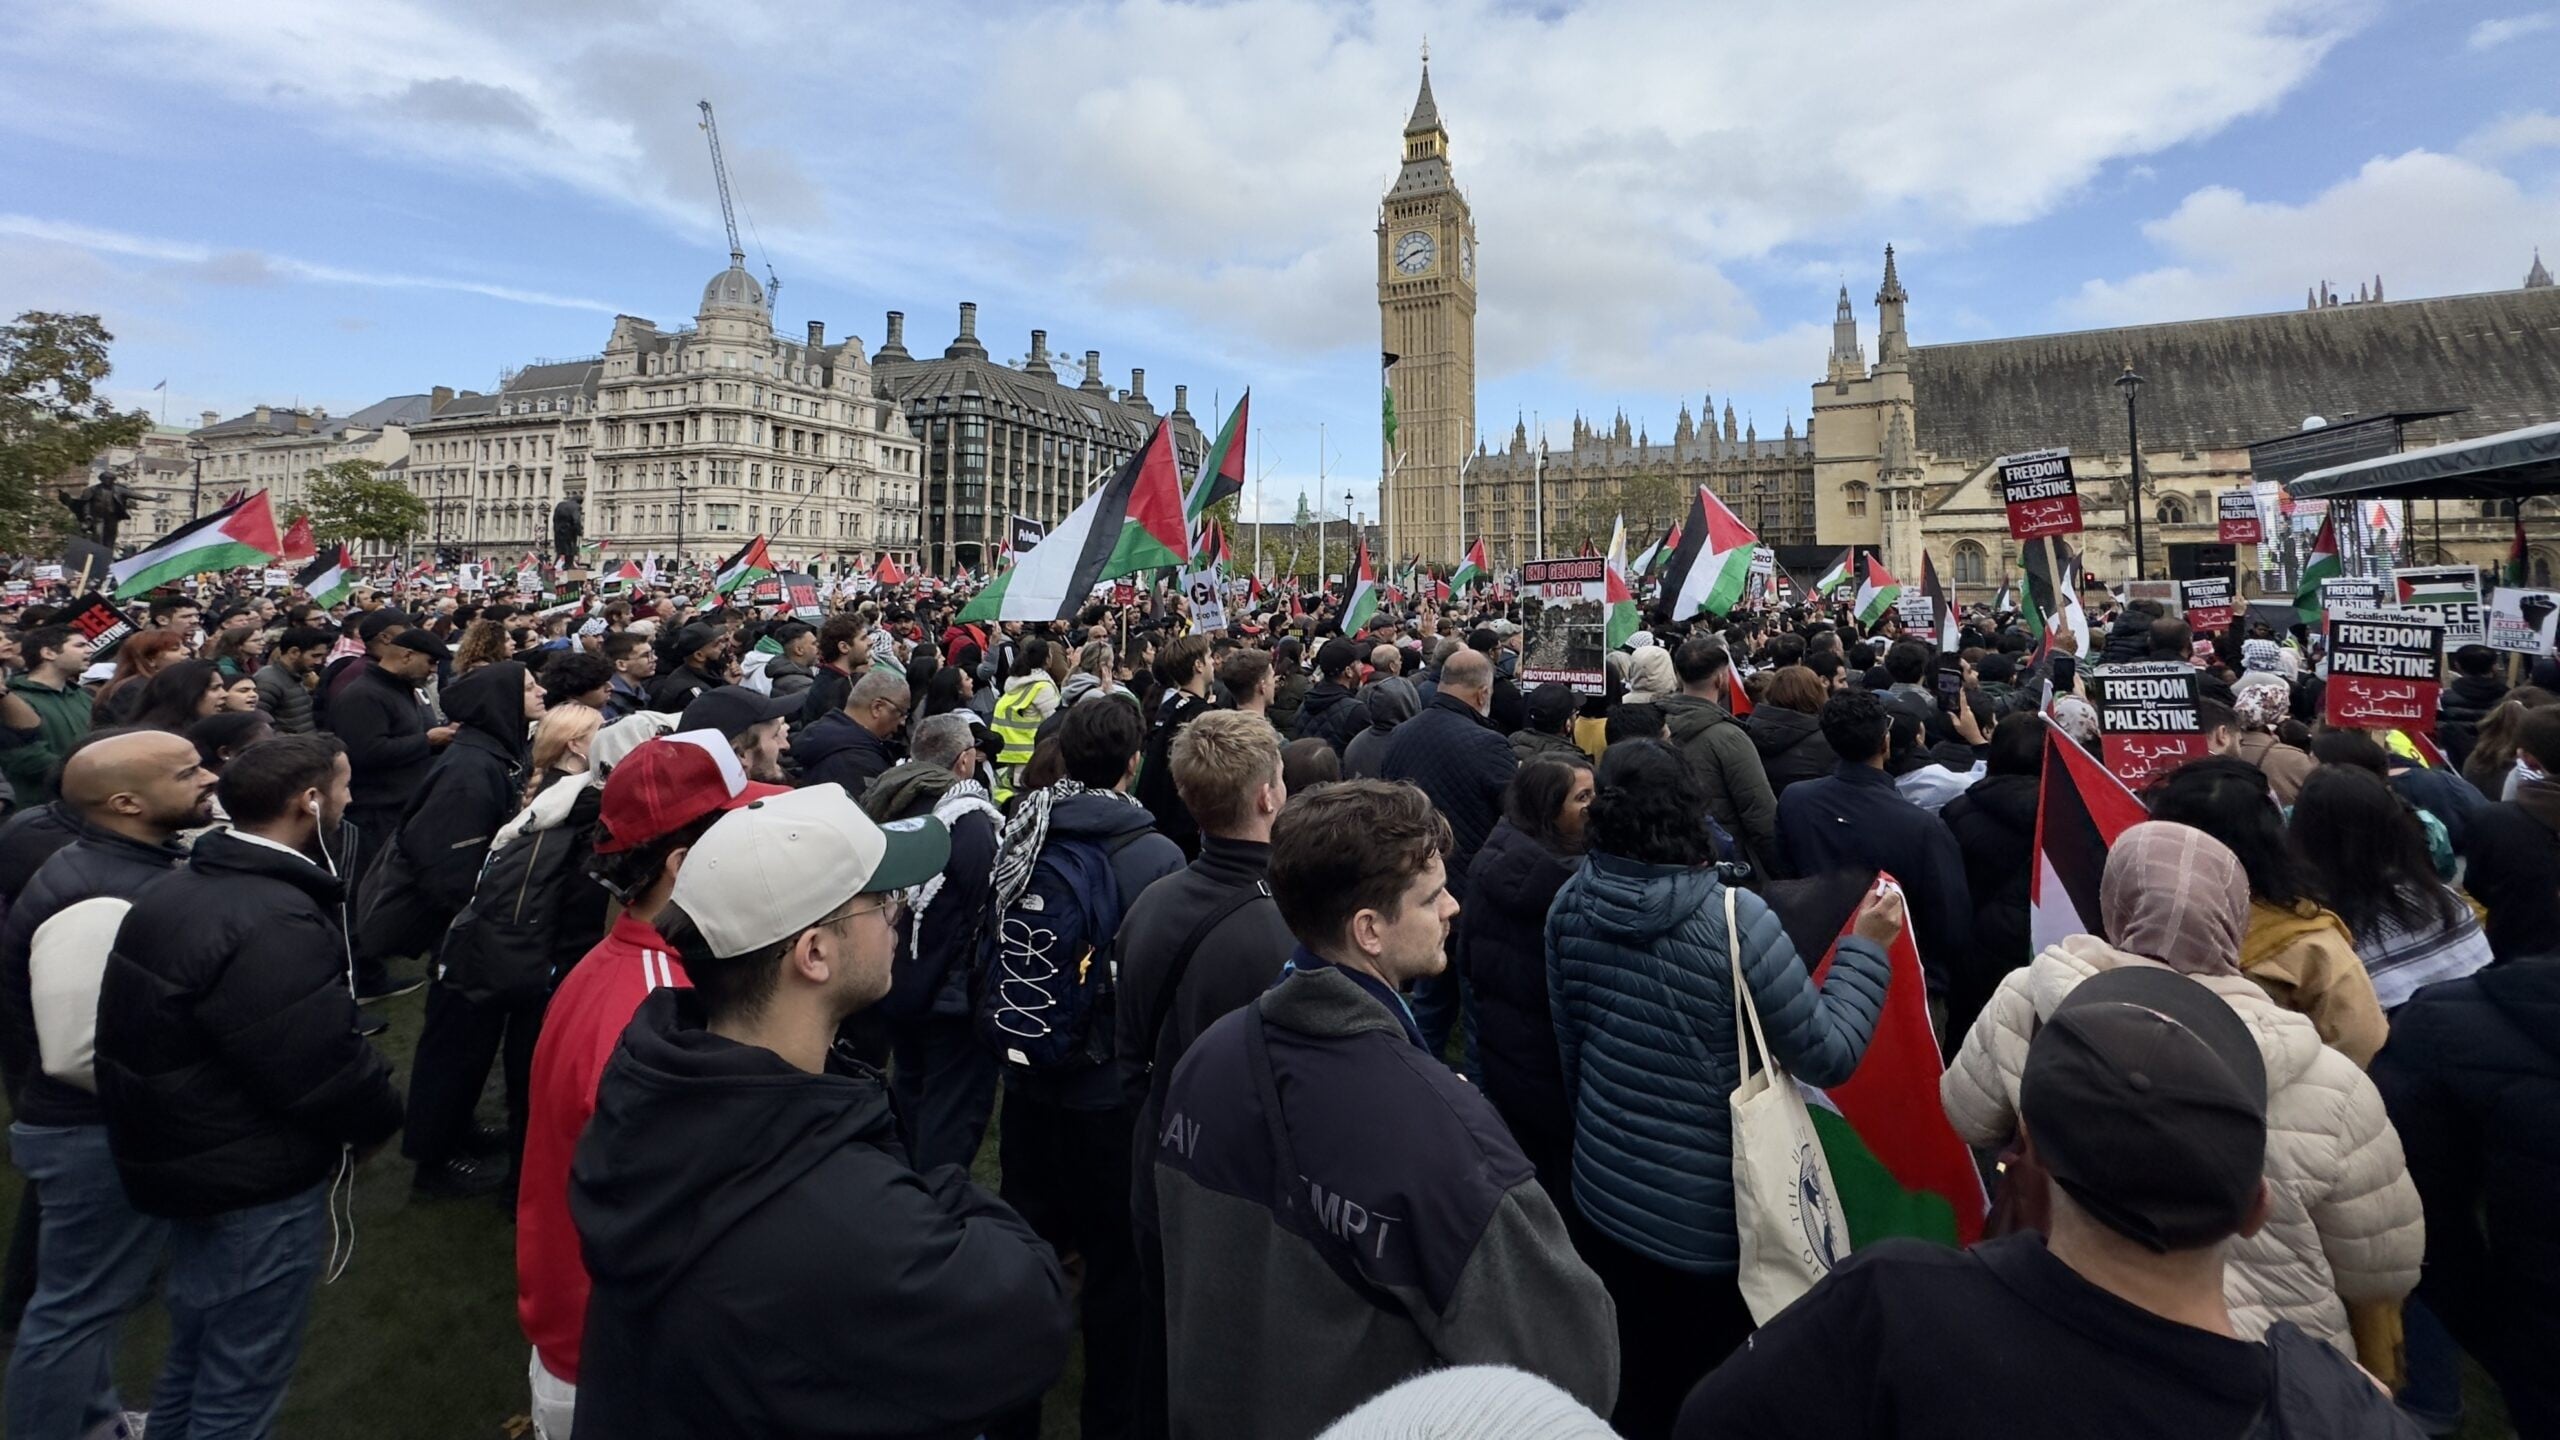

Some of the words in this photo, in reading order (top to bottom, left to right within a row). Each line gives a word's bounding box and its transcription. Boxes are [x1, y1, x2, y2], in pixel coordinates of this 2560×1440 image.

[2005, 460, 2065, 482] FREEDOM
[2006, 480, 2072, 501] PALESTINE
[2021, 501, 2064, 517] الحرية
[2221, 497, 2254, 506] FREEDOM
[2020, 513, 2073, 532] لفلسطين
[1526, 564, 1546, 581] END
[1549, 561, 1601, 579] GENOCIDE
[1541, 583, 1551, 598] IN
[1555, 582, 1583, 597] GAZA
[2188, 584, 2227, 596] FREEDOM
[2327, 585, 2374, 595] FREEDOM
[2188, 597, 2232, 608] PALESTINE
[2324, 599, 2377, 609] PALESTINE
[69, 604, 121, 640] REE
[2345, 611, 2389, 621] Socialist
[2390, 613, 2428, 624] Worker
[2338, 625, 2431, 649] FREEDOM
[2443, 624, 2481, 635] STINE
[2376, 645, 2393, 656] for
[2108, 665, 2147, 674] Socialist
[2148, 664, 2179, 673] Worker
[2333, 653, 2435, 678] PALESTINE
[1522, 670, 1603, 683] #BOYCOTTAPARTHEID
[2104, 679, 2188, 700] FREEDOM
[2349, 680, 2416, 701] الحرية
[2141, 699, 2157, 710] for
[2340, 700, 2422, 719] لفلسطين
[2103, 709, 2200, 730] PALESTINE
[2123, 738, 2187, 760] الحرية
[1159, 1111, 1200, 1159] AV
